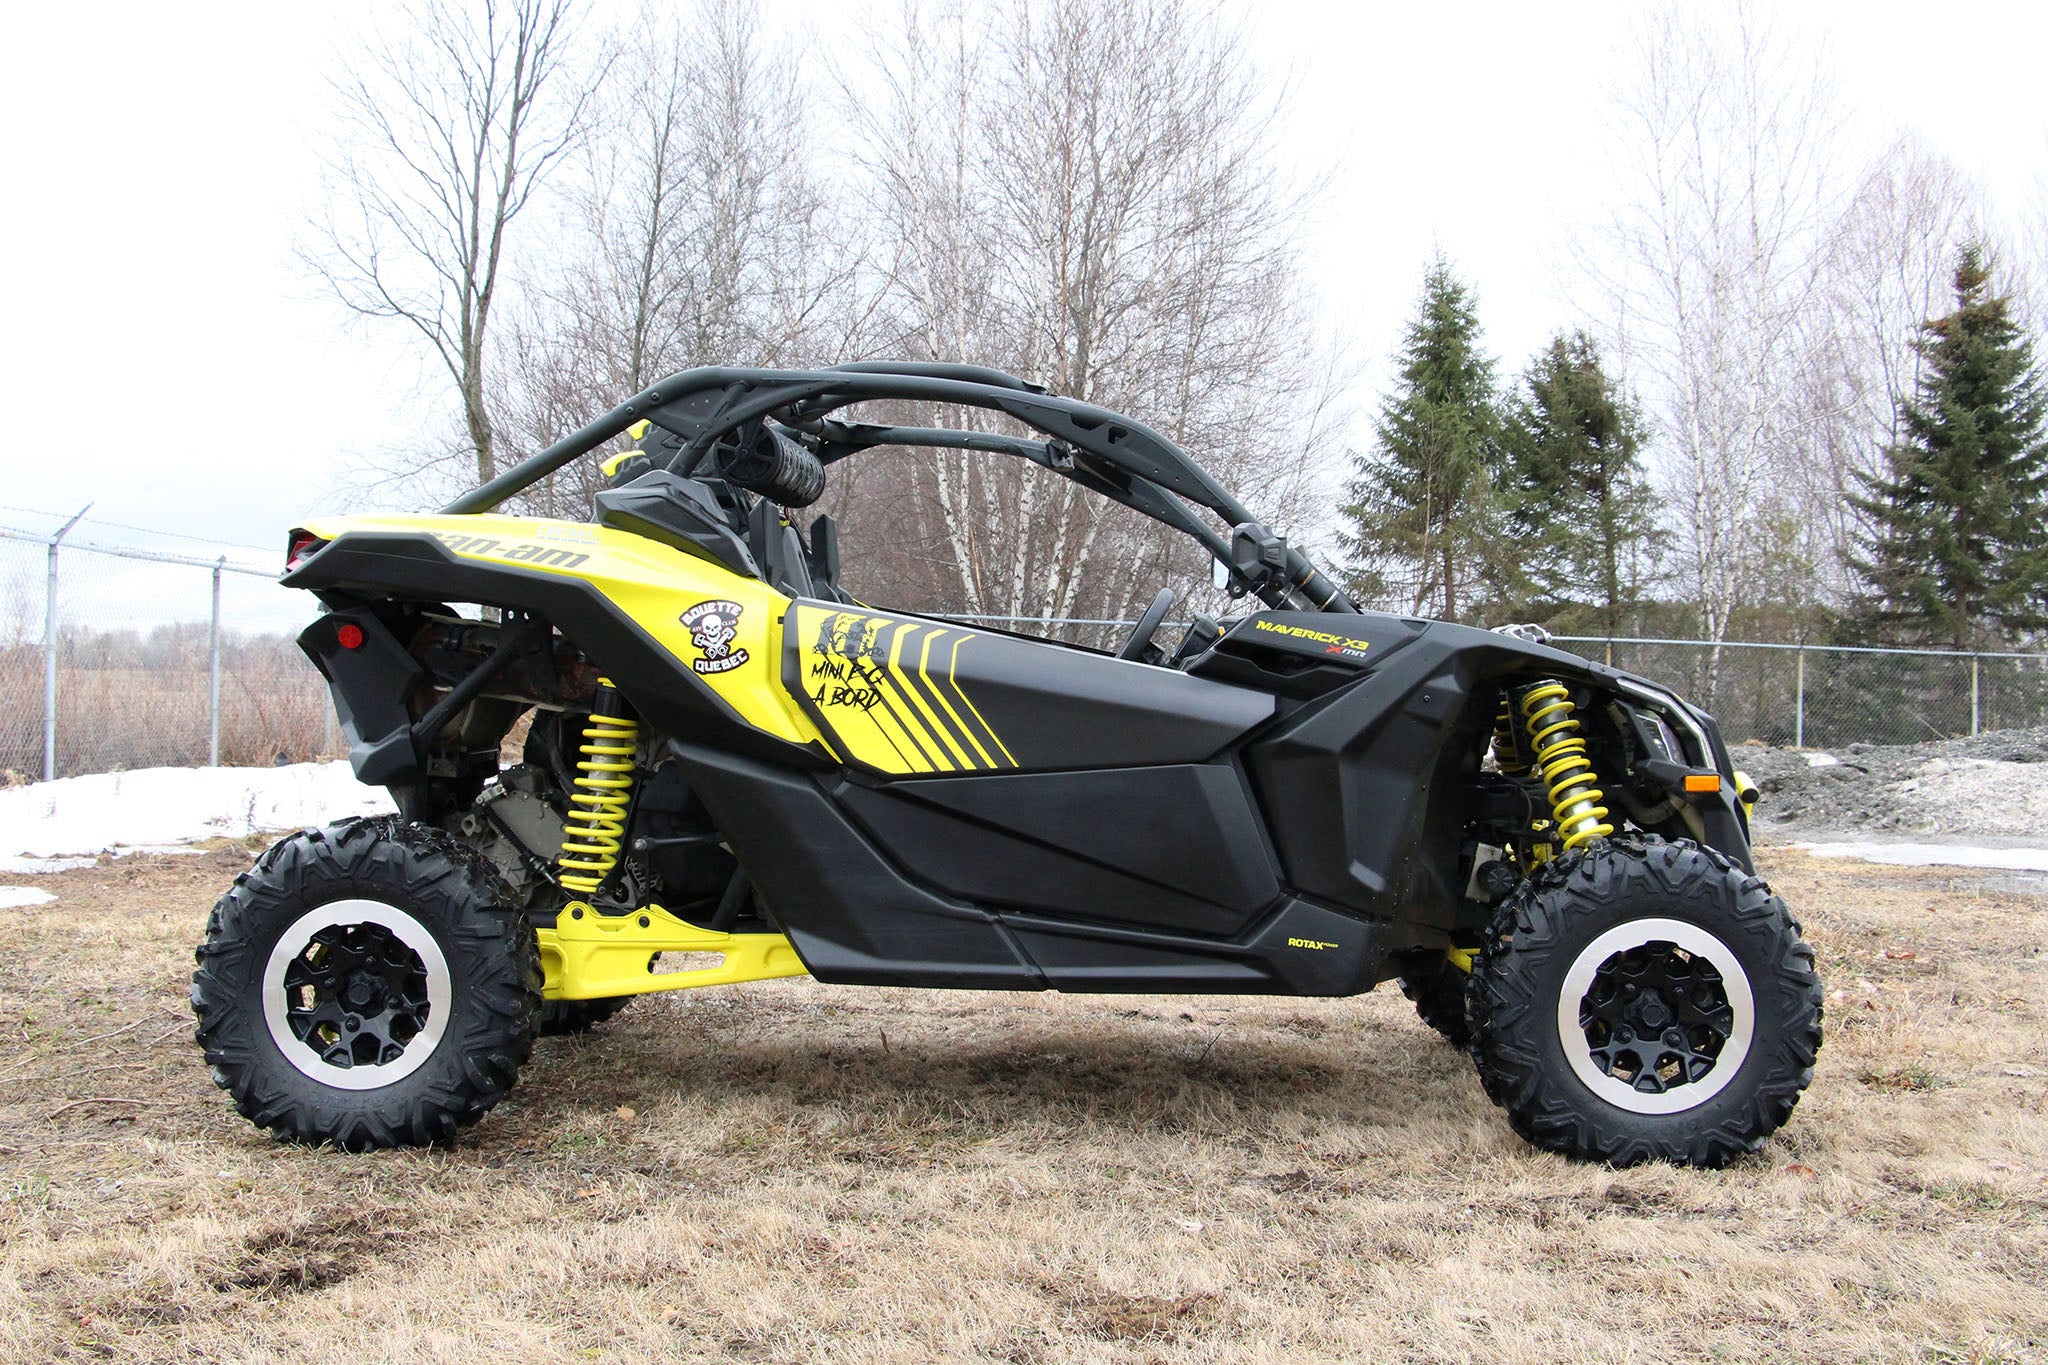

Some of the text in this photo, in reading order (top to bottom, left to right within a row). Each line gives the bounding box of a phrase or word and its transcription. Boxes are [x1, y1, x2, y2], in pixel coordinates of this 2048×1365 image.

[681, 601, 743, 626] BOUETTE
[1256, 620, 1369, 651] MAVERICK X3
[695, 650, 748, 673] QUEBEC
[811, 660, 844, 681] MINI
[826, 686, 881, 712] BORD
[1288, 937, 1323, 950] ROTAX
